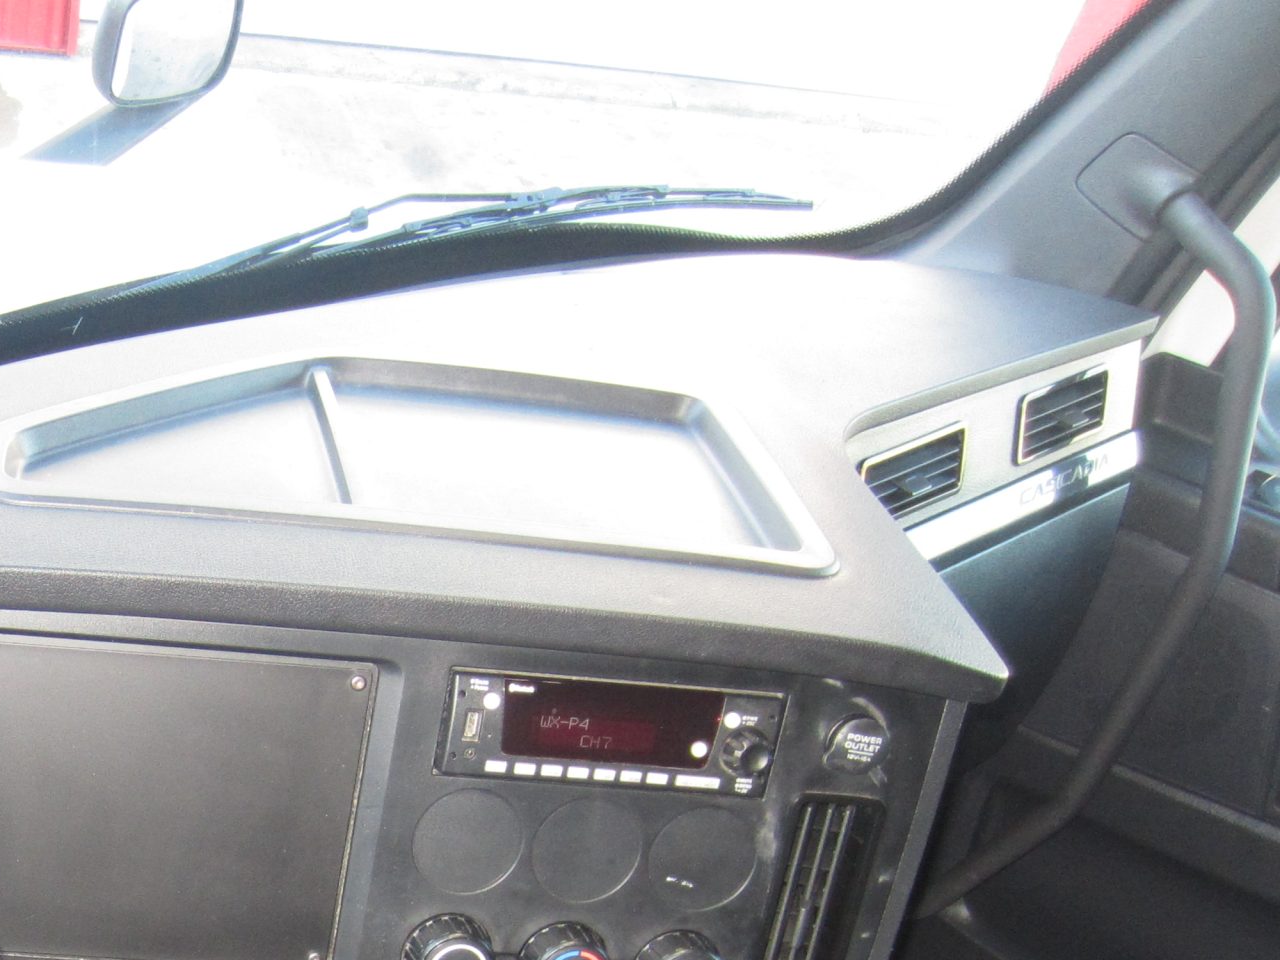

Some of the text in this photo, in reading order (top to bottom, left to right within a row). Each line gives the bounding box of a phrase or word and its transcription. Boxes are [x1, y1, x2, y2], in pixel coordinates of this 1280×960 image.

[1020, 453, 1108, 505] CASCADIA
[540, 715, 590, 730] WX-P4
[579, 735, 613, 749] CH7
[847, 733, 882, 745] POWER
[845, 741, 880, 752] OUTLET
